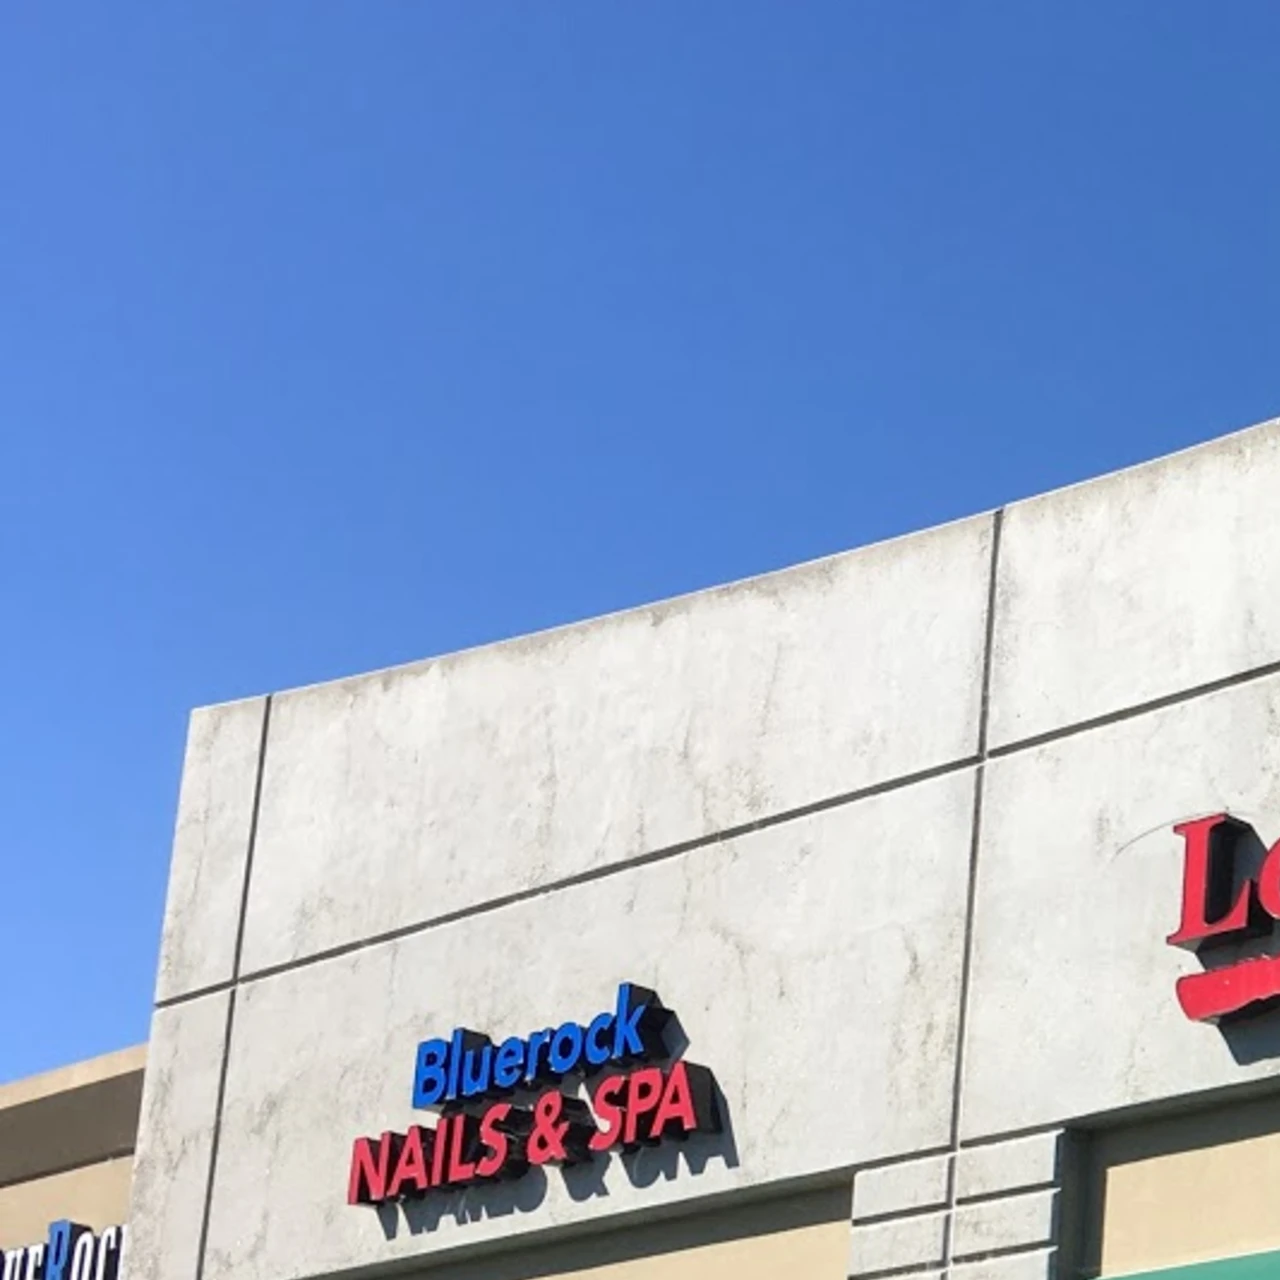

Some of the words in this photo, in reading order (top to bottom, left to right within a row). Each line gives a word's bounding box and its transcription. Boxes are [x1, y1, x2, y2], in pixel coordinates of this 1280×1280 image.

[412, 981, 646, 1109] Bluerock
[347, 1103, 512, 1206] NAILS
[526, 1090, 570, 1165] &
[588, 1060, 697, 1151] SPA
